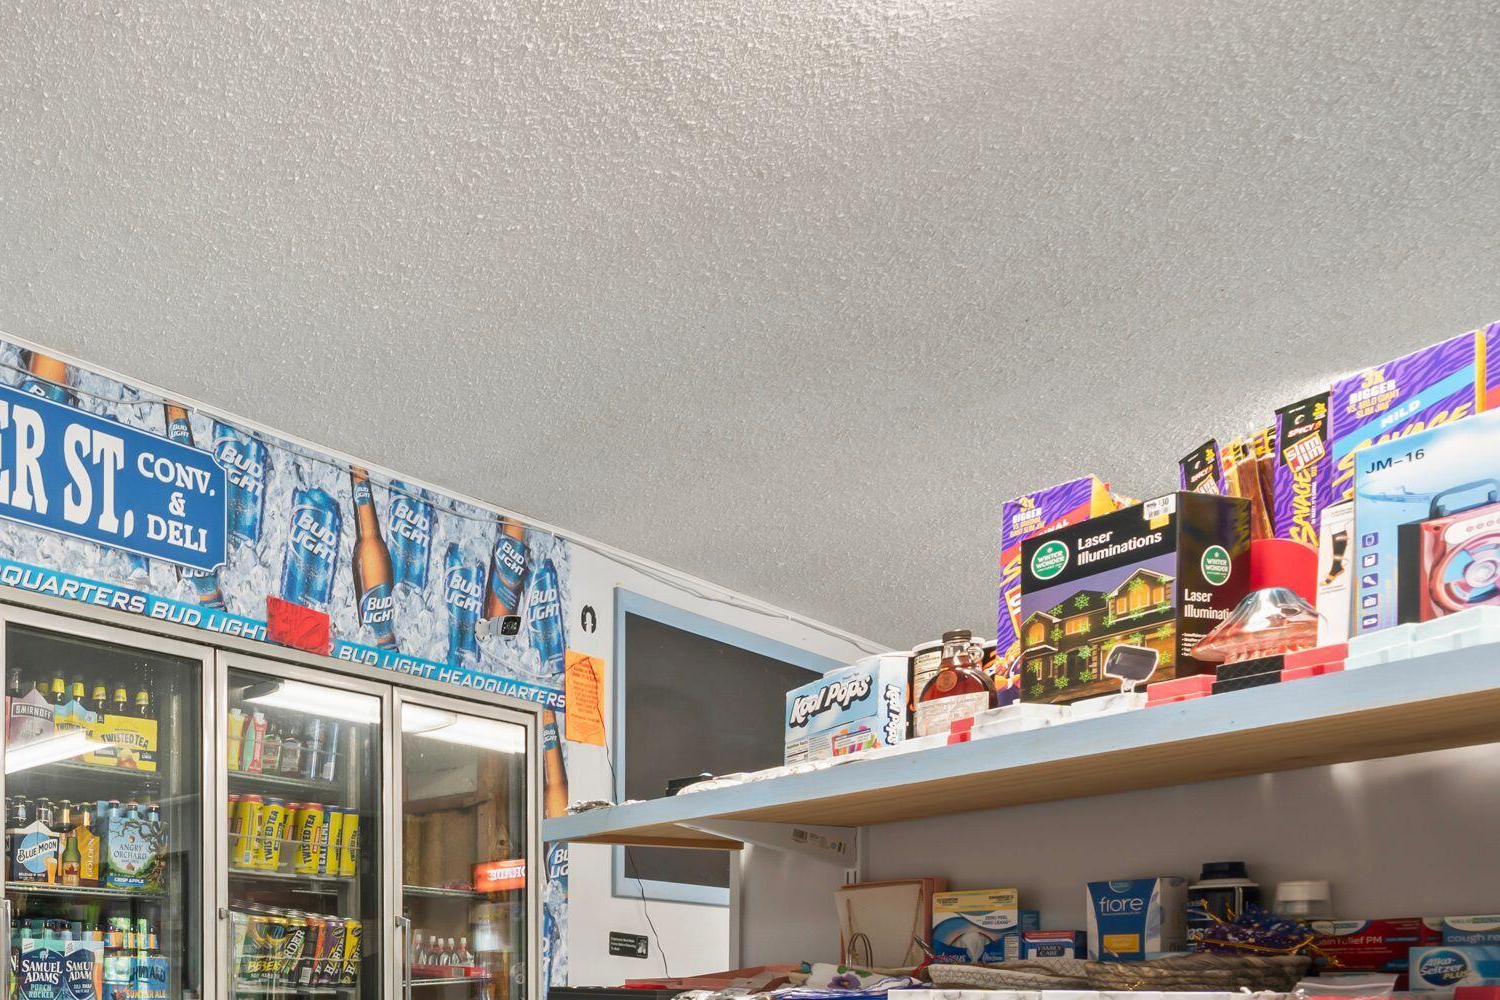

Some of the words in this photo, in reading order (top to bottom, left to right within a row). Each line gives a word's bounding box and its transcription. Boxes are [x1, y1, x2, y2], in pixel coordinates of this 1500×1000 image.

[1381, 400, 1421, 428] MILD
[220, 441, 262, 476] BUD
[63, 422, 134, 538] ST.
[137, 452, 216, 497] CONV.
[169, 491, 187, 516] &
[393, 500, 430, 532] BUD
[146, 513, 208, 554] DELI
[297, 508, 338, 547] BUD
[388, 516, 432, 548] LIGHT
[291, 527, 338, 564] LIGHT
[500, 539, 527, 564] BUD
[1078, 532, 1113, 550] Laser
[1078, 533, 1162, 566] Illuminations
[496, 551, 527, 577] LIGHT
[1035, 556, 1065, 569] WONDER
[1037, 551, 1063, 563] WINTER
[449, 573, 482, 598] BUD
[1184, 589, 1212, 602] Laser
[366, 596, 394, 610] BUD
[445, 586, 483, 614] LIGHT
[530, 589, 559, 607] BUD
[151, 601, 202, 626] BUD
[362, 607, 397, 623] LIGHT
[528, 602, 562, 621] LIGHT
[338, 645, 379, 669] BUD
[383, 655, 437, 680] LIGHT
[438, 668, 566, 709] HEADQUARTERS
[790, 686, 828, 724] Kool
[825, 675, 871, 709] Pops
[16, 705, 52, 720] SMIRNOFF
[101, 733, 134, 743] TWISTED
[135, 735, 149, 749] TEA
[18, 847, 37, 862] BLUE
[38, 841, 57, 852] MOON
[114, 850, 147, 859] ORCHARD
[1100, 897, 1143, 912] fiore
[1447, 934, 1485, 943] cough
[22, 959, 63, 973] SAMUEL
[1420, 964, 1464, 976] Seltzer
[1425, 958, 1456, 966] Alka-
[25, 972, 59, 984] ADAMS
[1444, 971, 1469, 979] PLUS
